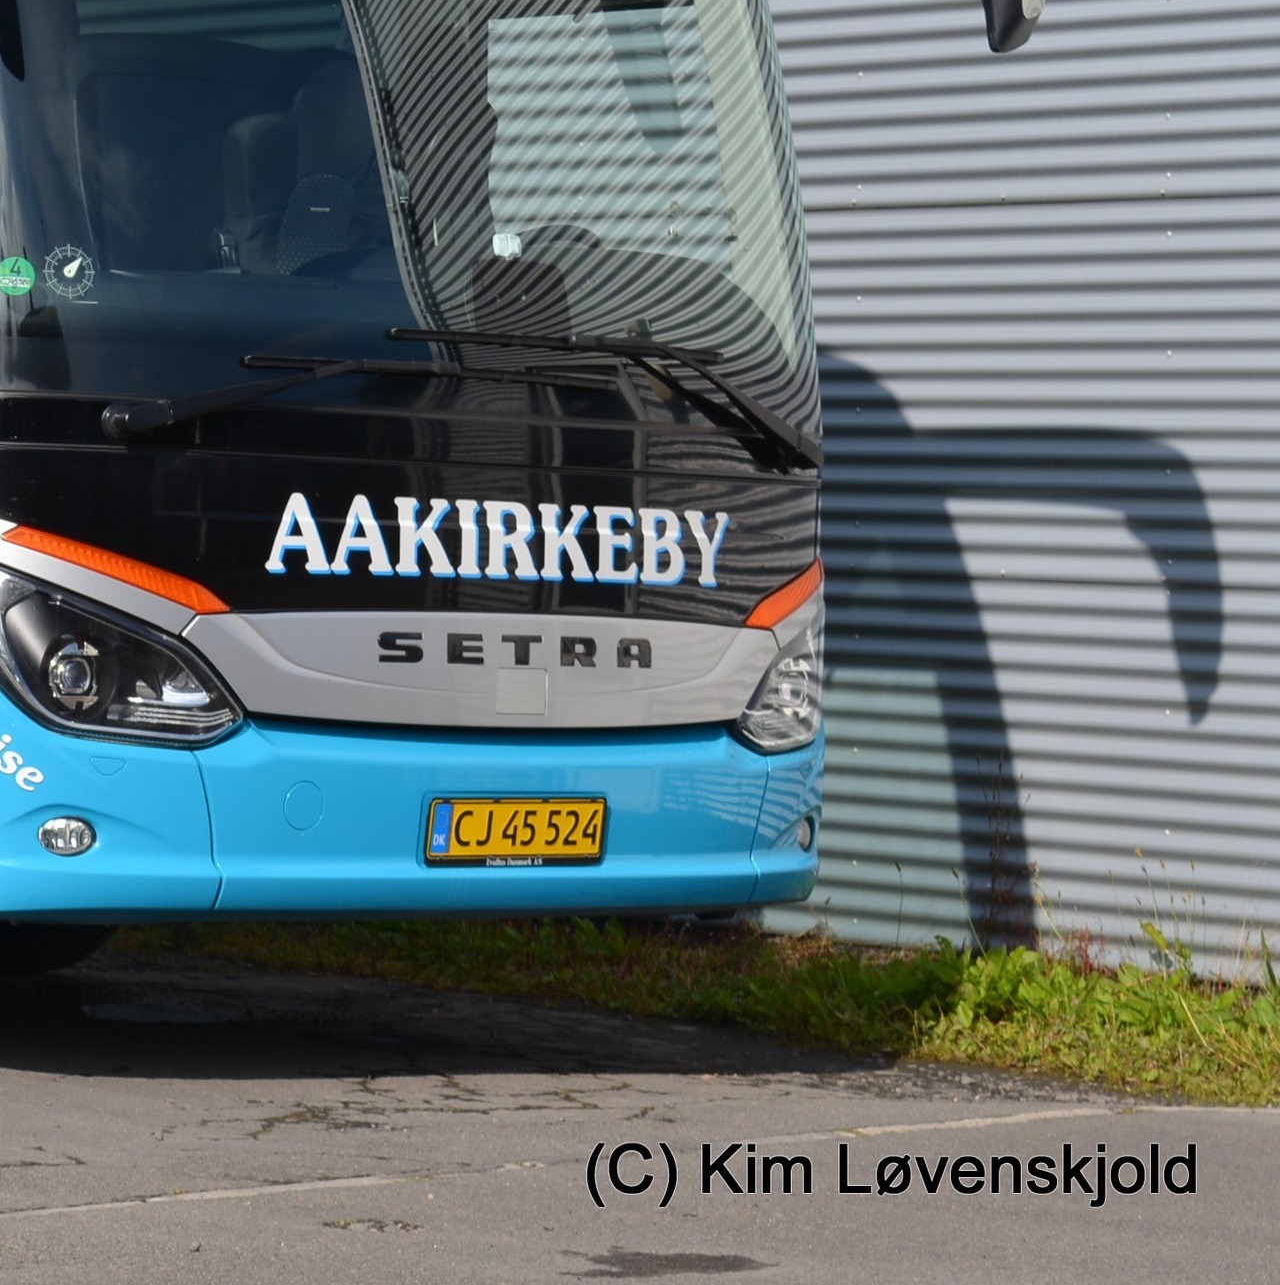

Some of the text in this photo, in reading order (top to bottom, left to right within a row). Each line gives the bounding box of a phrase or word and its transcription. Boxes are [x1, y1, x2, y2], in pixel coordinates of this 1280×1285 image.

[10, 258, 21, 276] 4
[265, 492, 731, 588] AAKIRKEBY
[377, 632, 652, 670] SETRA
[433, 834, 445, 846] DK
[454, 809, 599, 847] CJ 45 524
